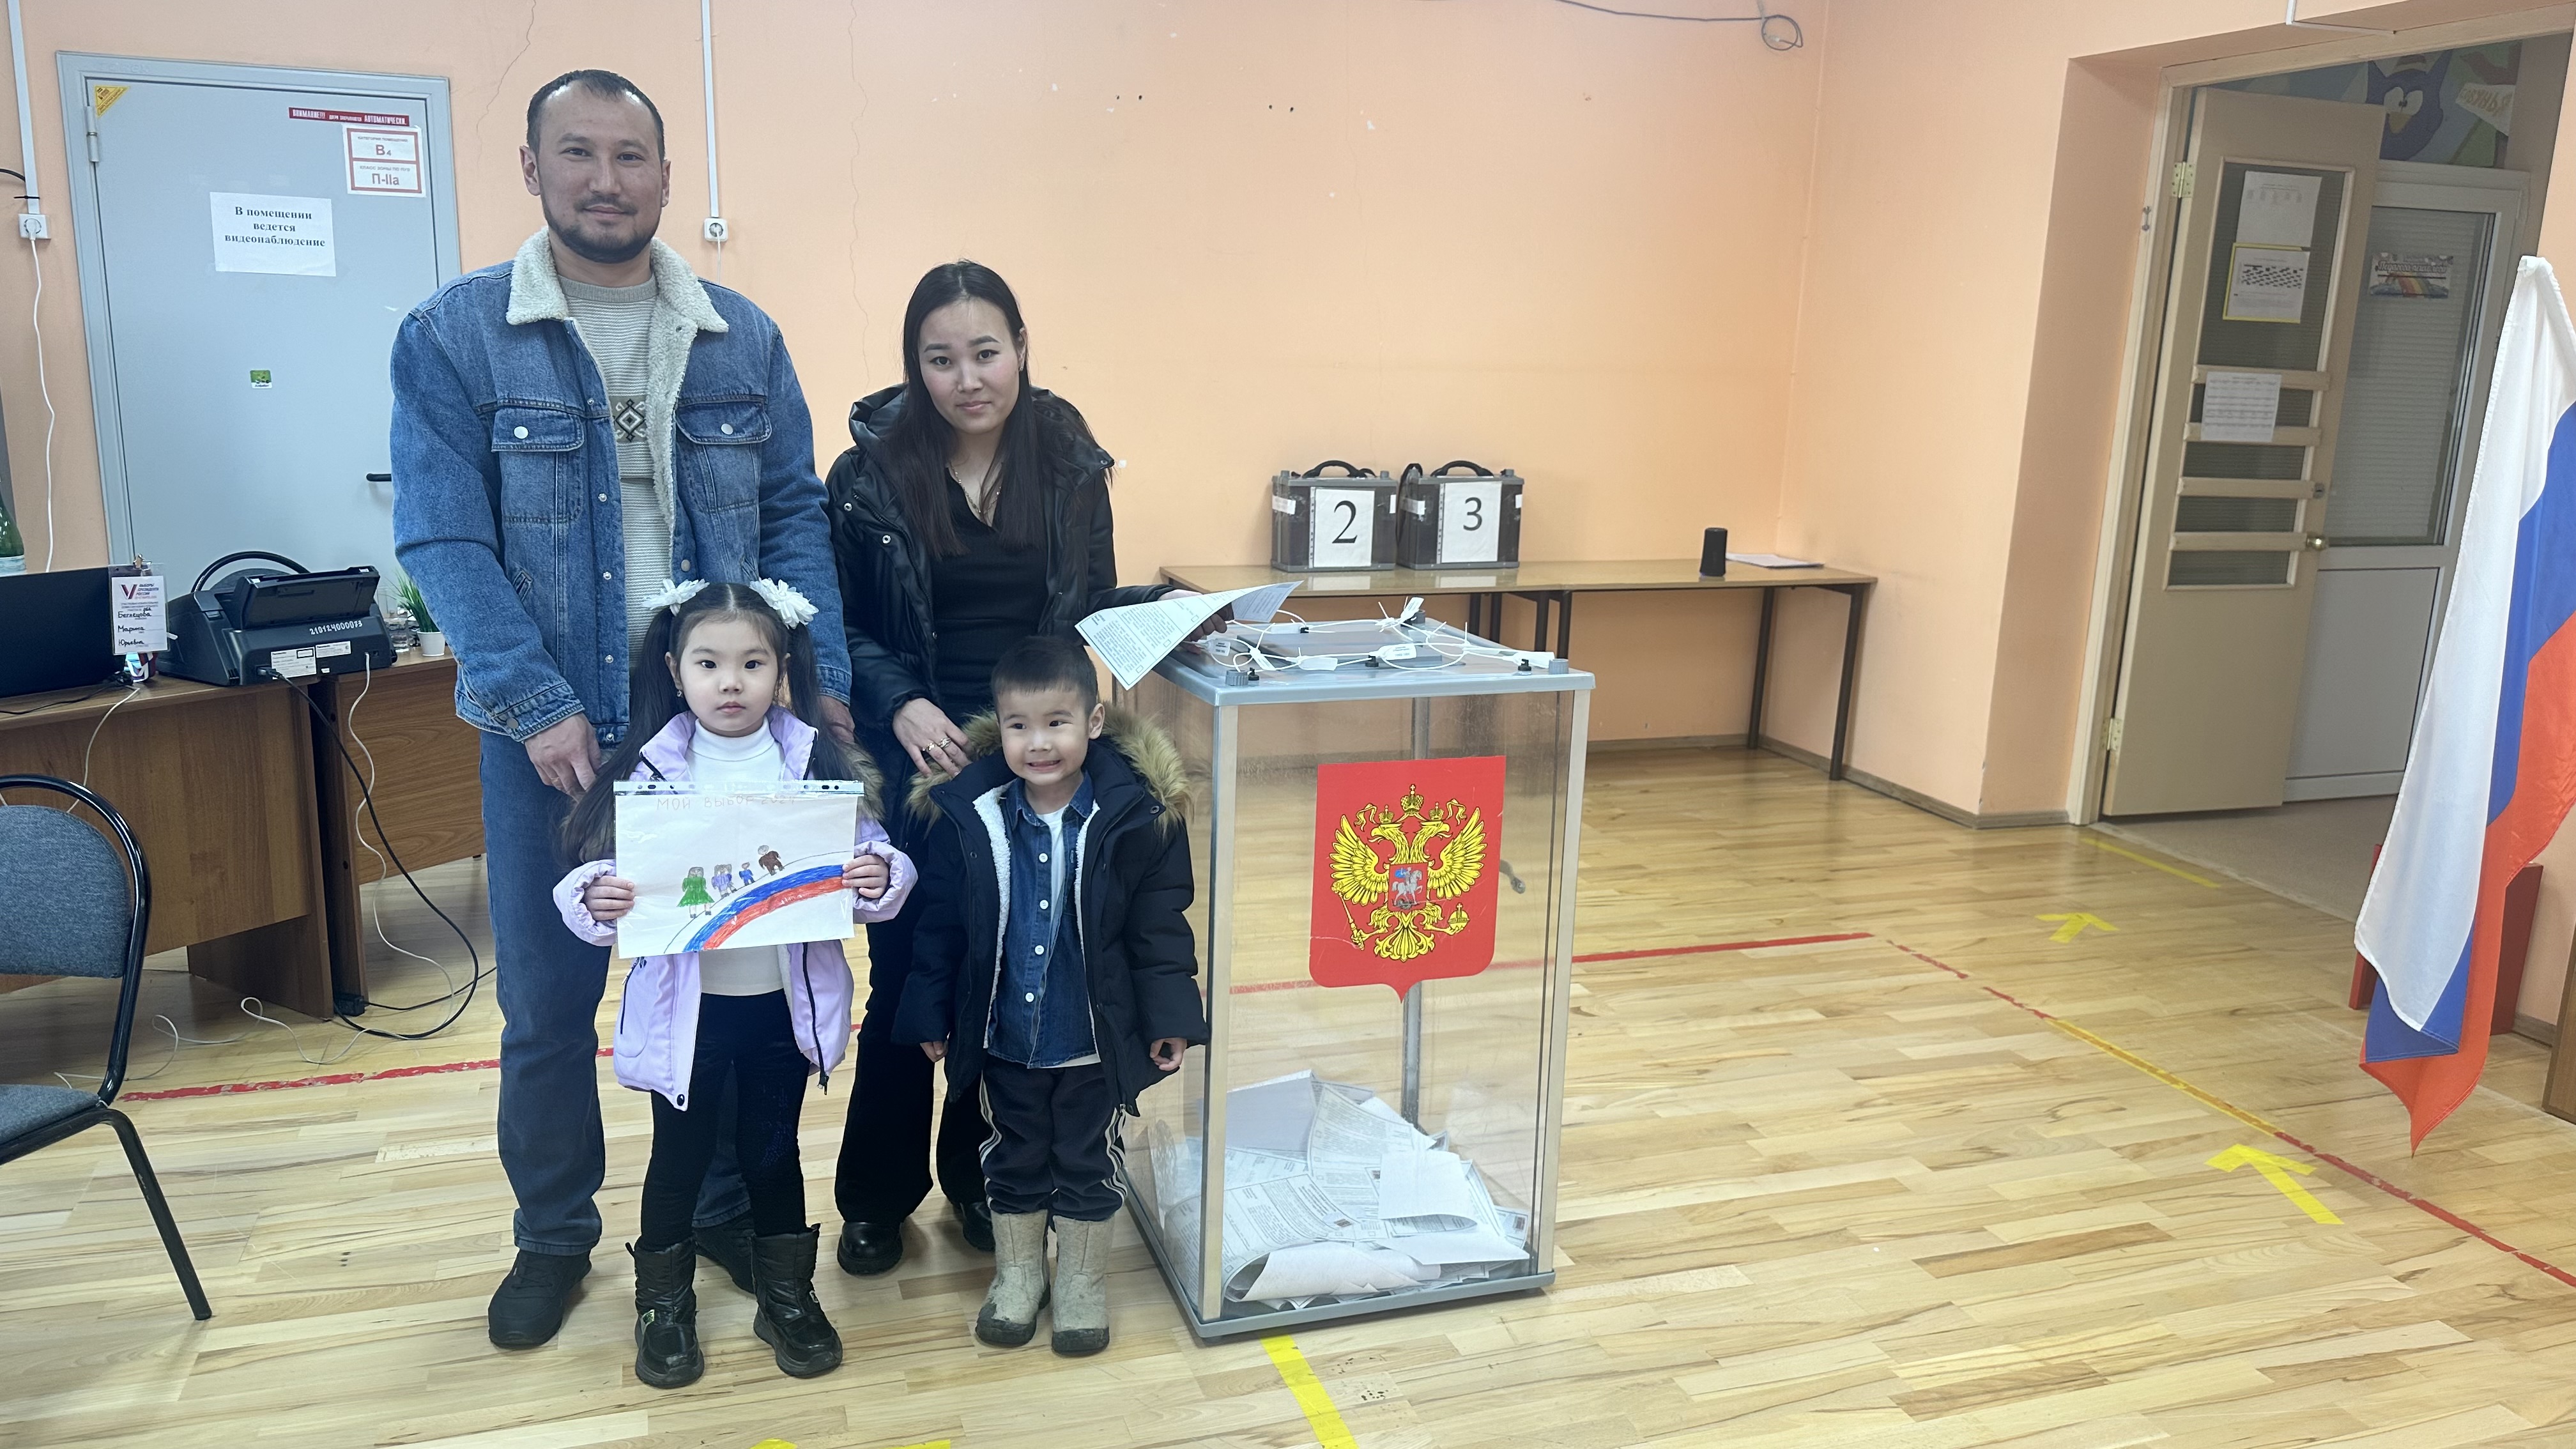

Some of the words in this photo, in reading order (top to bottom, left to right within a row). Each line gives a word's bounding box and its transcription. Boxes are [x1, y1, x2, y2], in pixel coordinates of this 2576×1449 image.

[235, 206, 243, 215] В
[247, 209, 312, 219] помещении
[225, 234, 325, 247] видеонаблюдение
[1463, 497, 1482, 531] 3
[1331, 500, 1358, 544] 2
[657, 796, 691, 811] МОЙ
